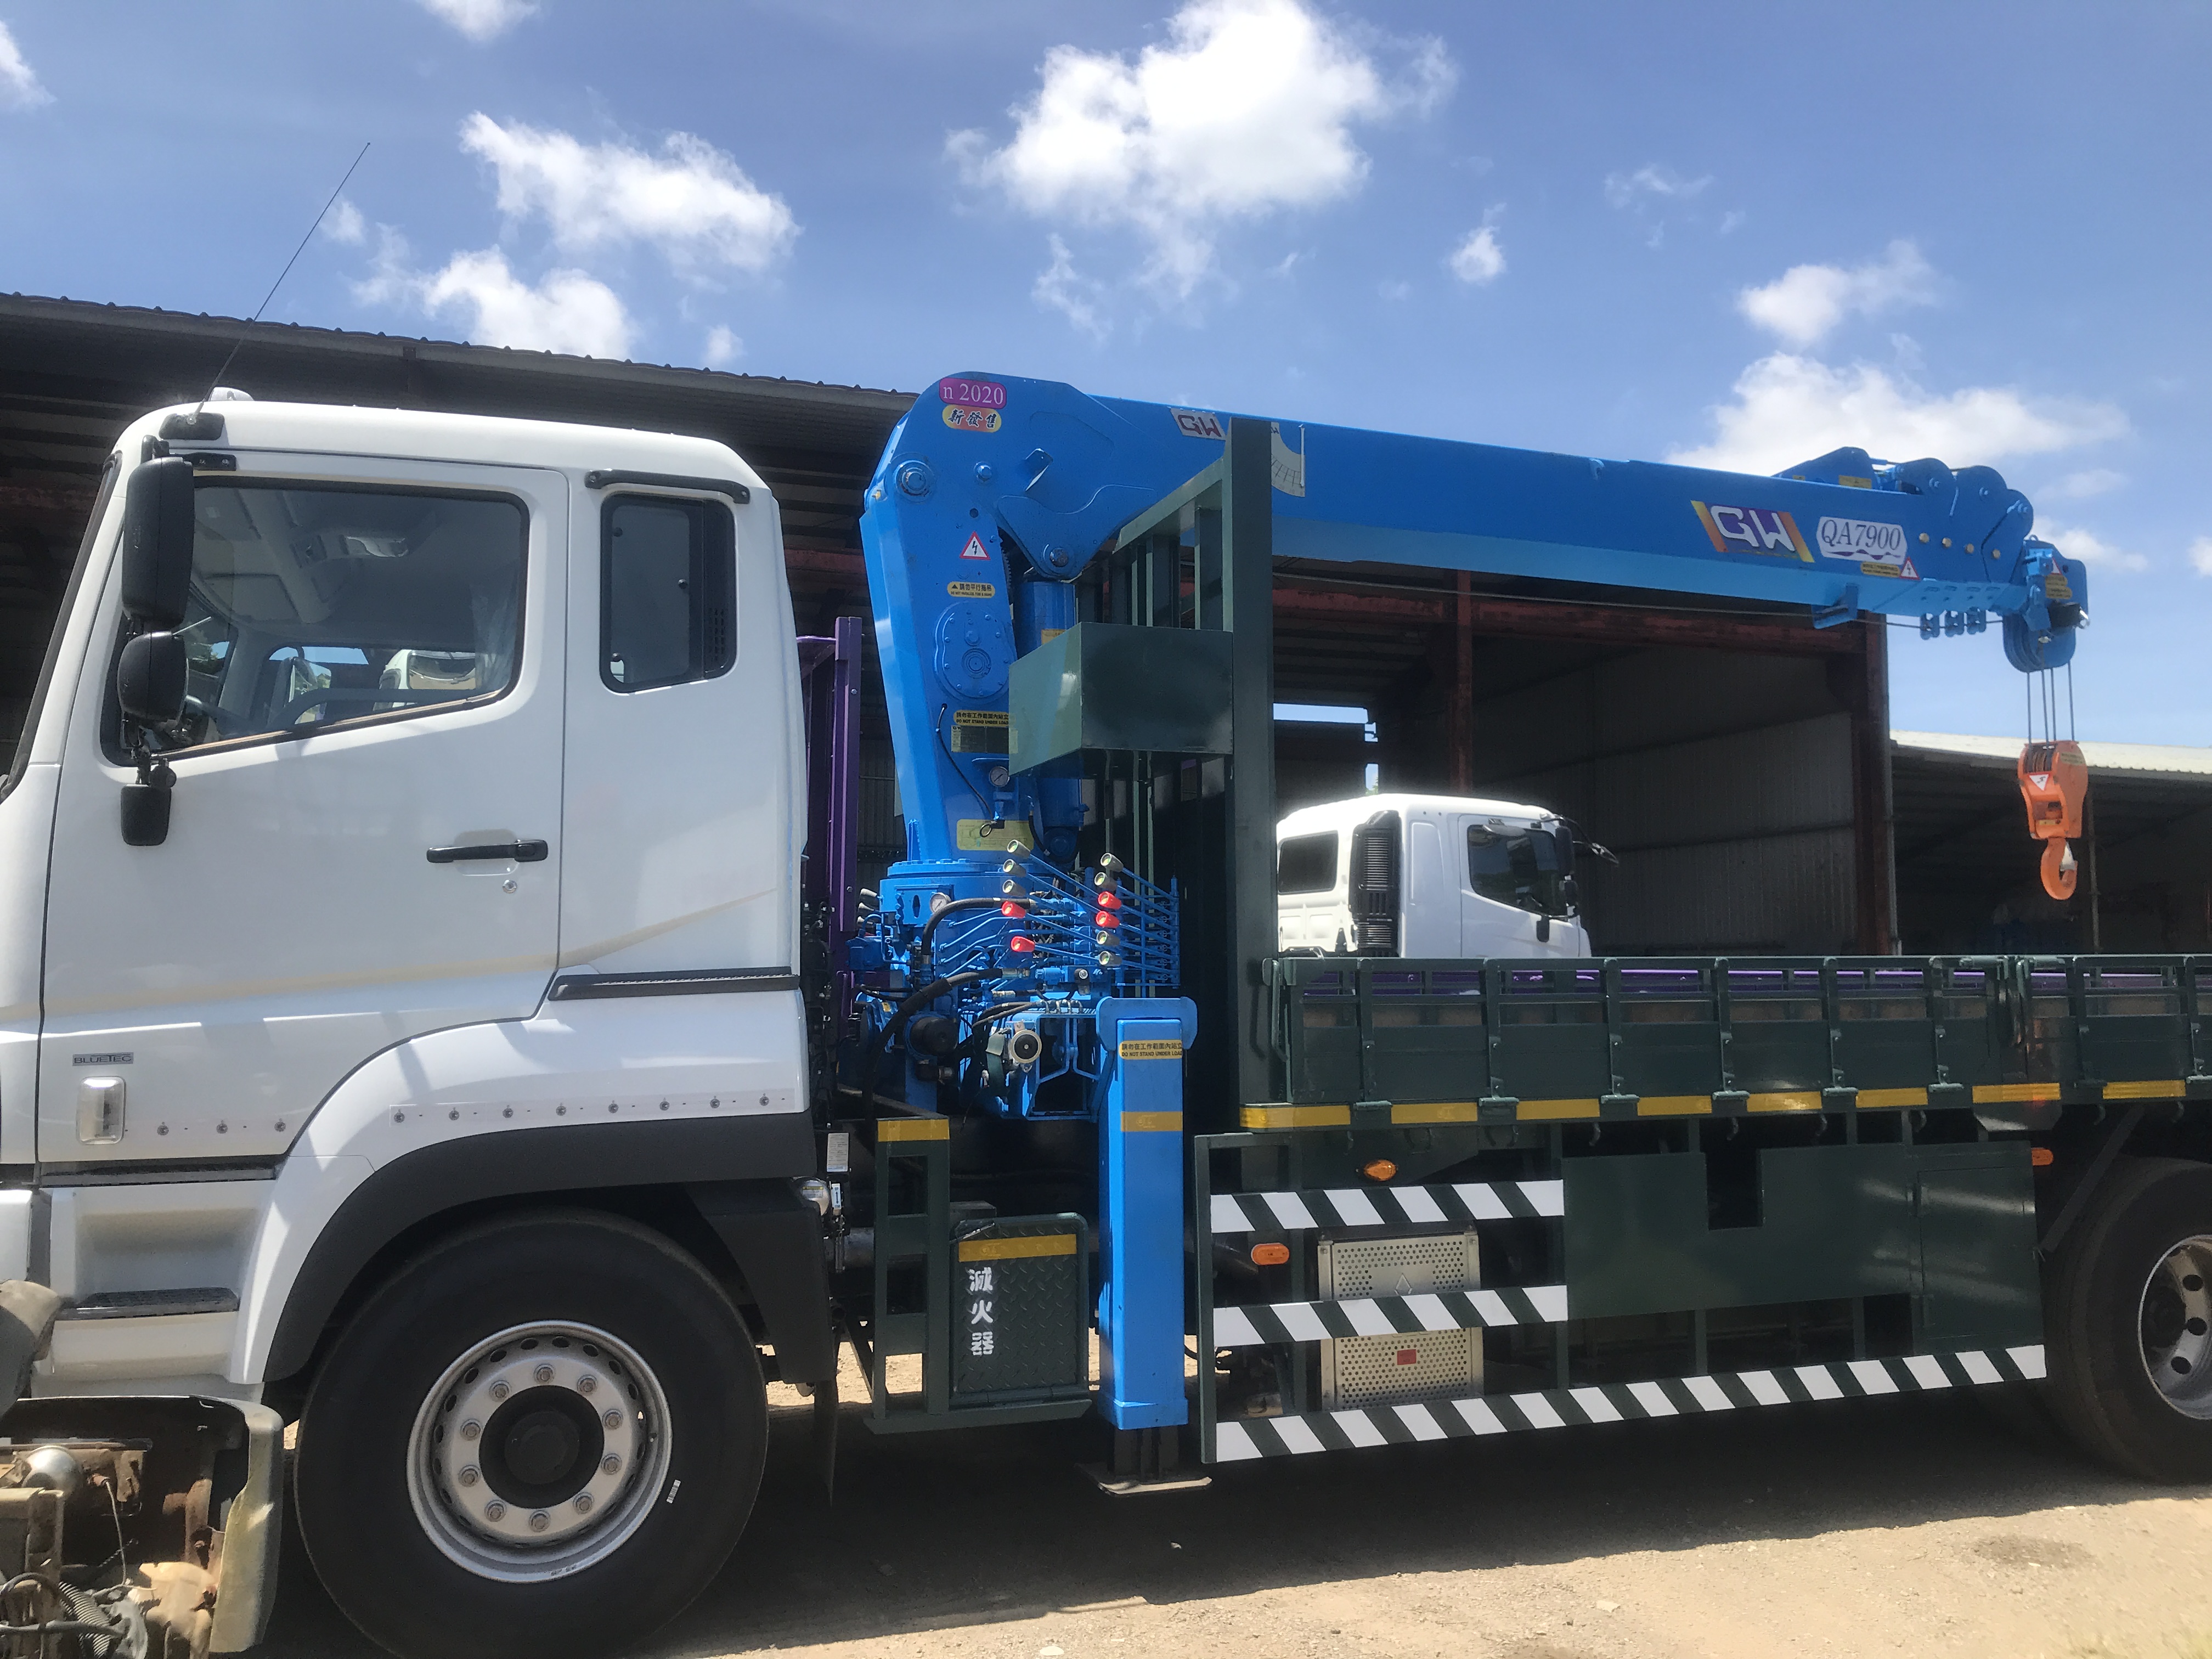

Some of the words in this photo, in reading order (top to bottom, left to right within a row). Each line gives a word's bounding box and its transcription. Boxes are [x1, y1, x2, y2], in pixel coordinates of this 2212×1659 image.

[960, 383, 1003, 405] 2020
[947, 408, 998, 429] 新發售
[1178, 415, 1222, 438] GW
[1710, 505, 1796, 551] GW
[1821, 519, 1901, 550] QA7900
[74, 1053, 132, 1063] BLUETEC
